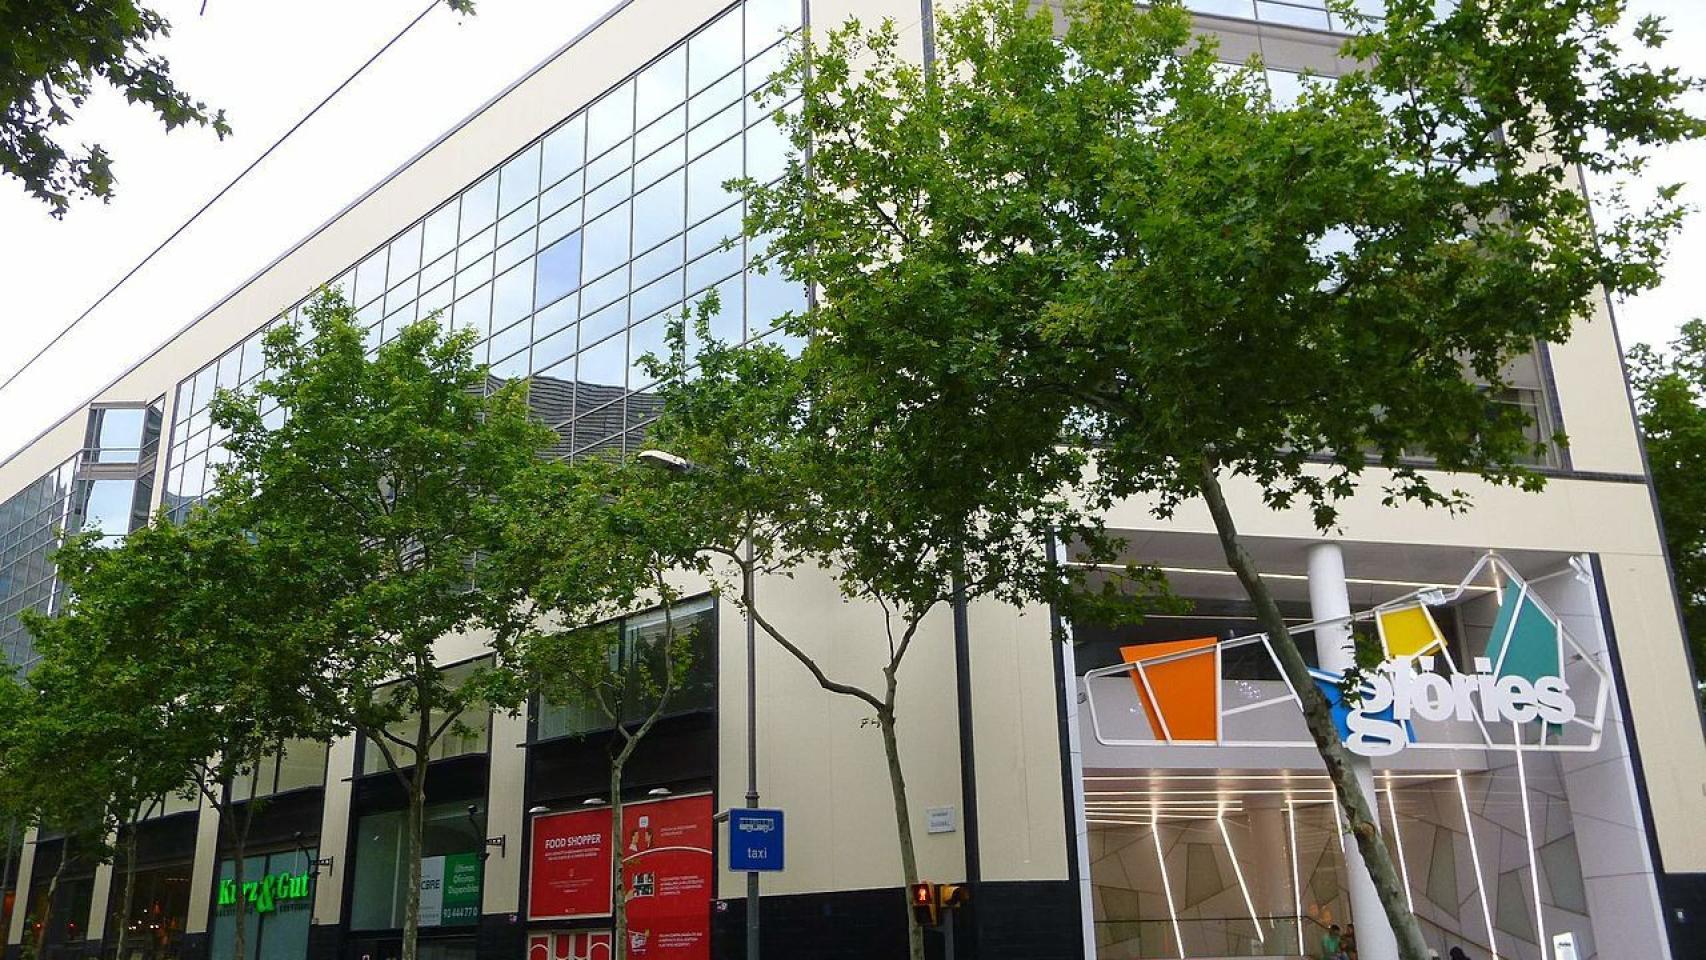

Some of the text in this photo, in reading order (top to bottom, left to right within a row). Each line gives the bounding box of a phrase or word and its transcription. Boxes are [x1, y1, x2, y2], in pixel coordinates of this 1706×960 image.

[545, 834, 601, 848] FOOD SHOPPER
[747, 847, 767, 859] taxi
[421, 879, 440, 890] CBRE
